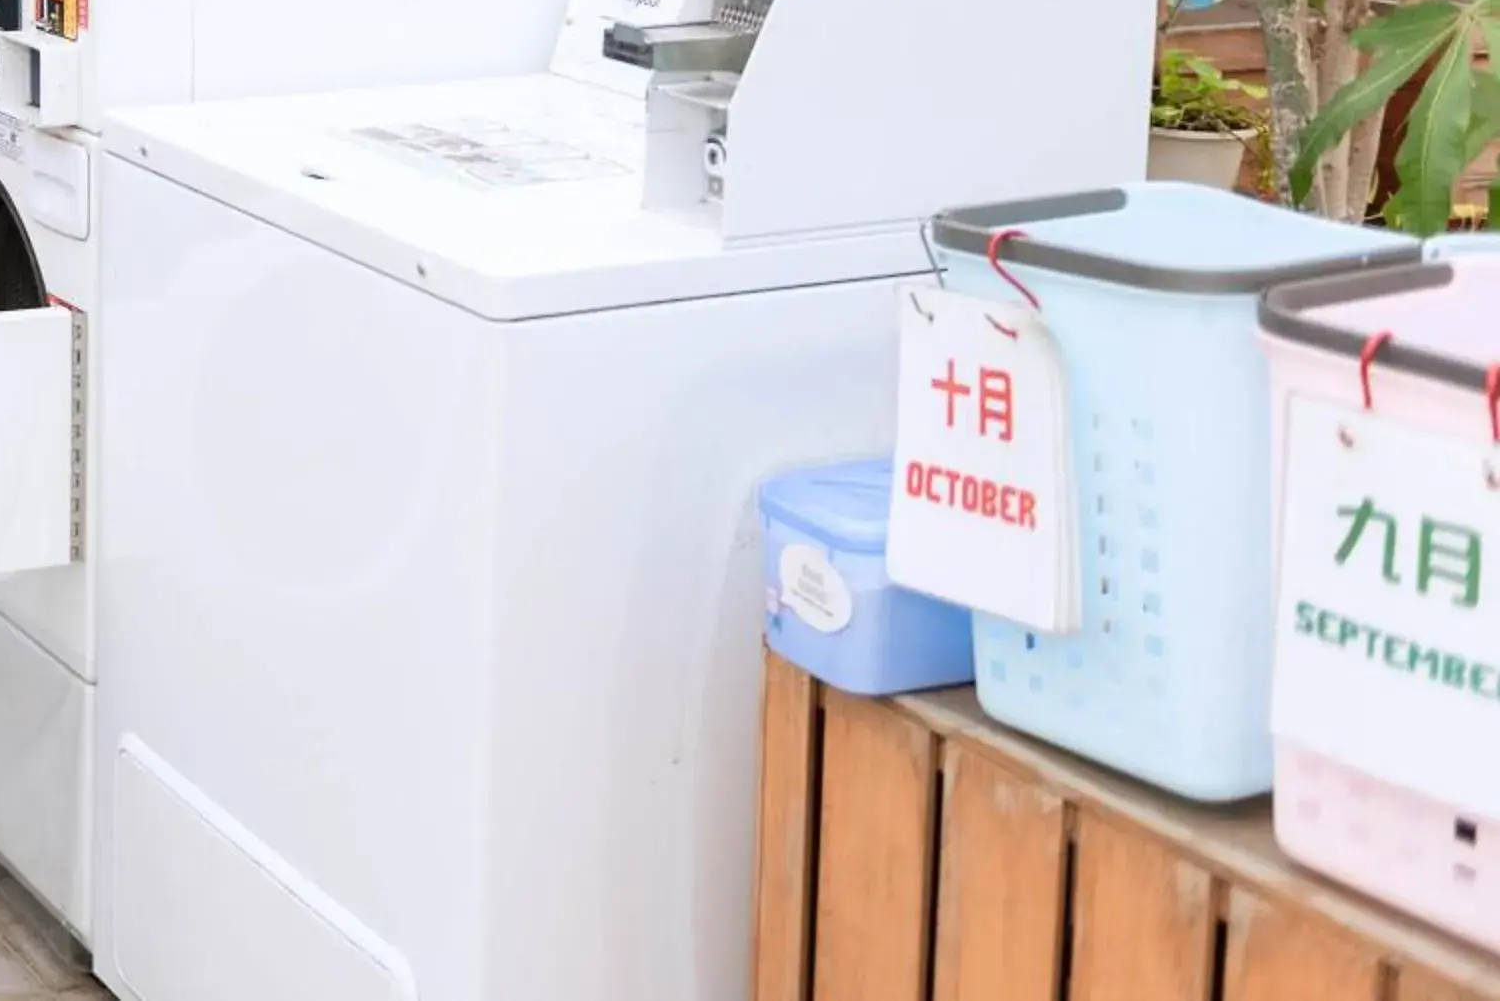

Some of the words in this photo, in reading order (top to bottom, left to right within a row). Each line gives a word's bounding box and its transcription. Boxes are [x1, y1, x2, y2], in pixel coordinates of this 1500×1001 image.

[931, 359, 1014, 441] 十月
[906, 461, 1037, 530] OCTOBER
[1334, 496, 1482, 608] 九月
[1295, 600, 1500, 703] SEPTEMBE
